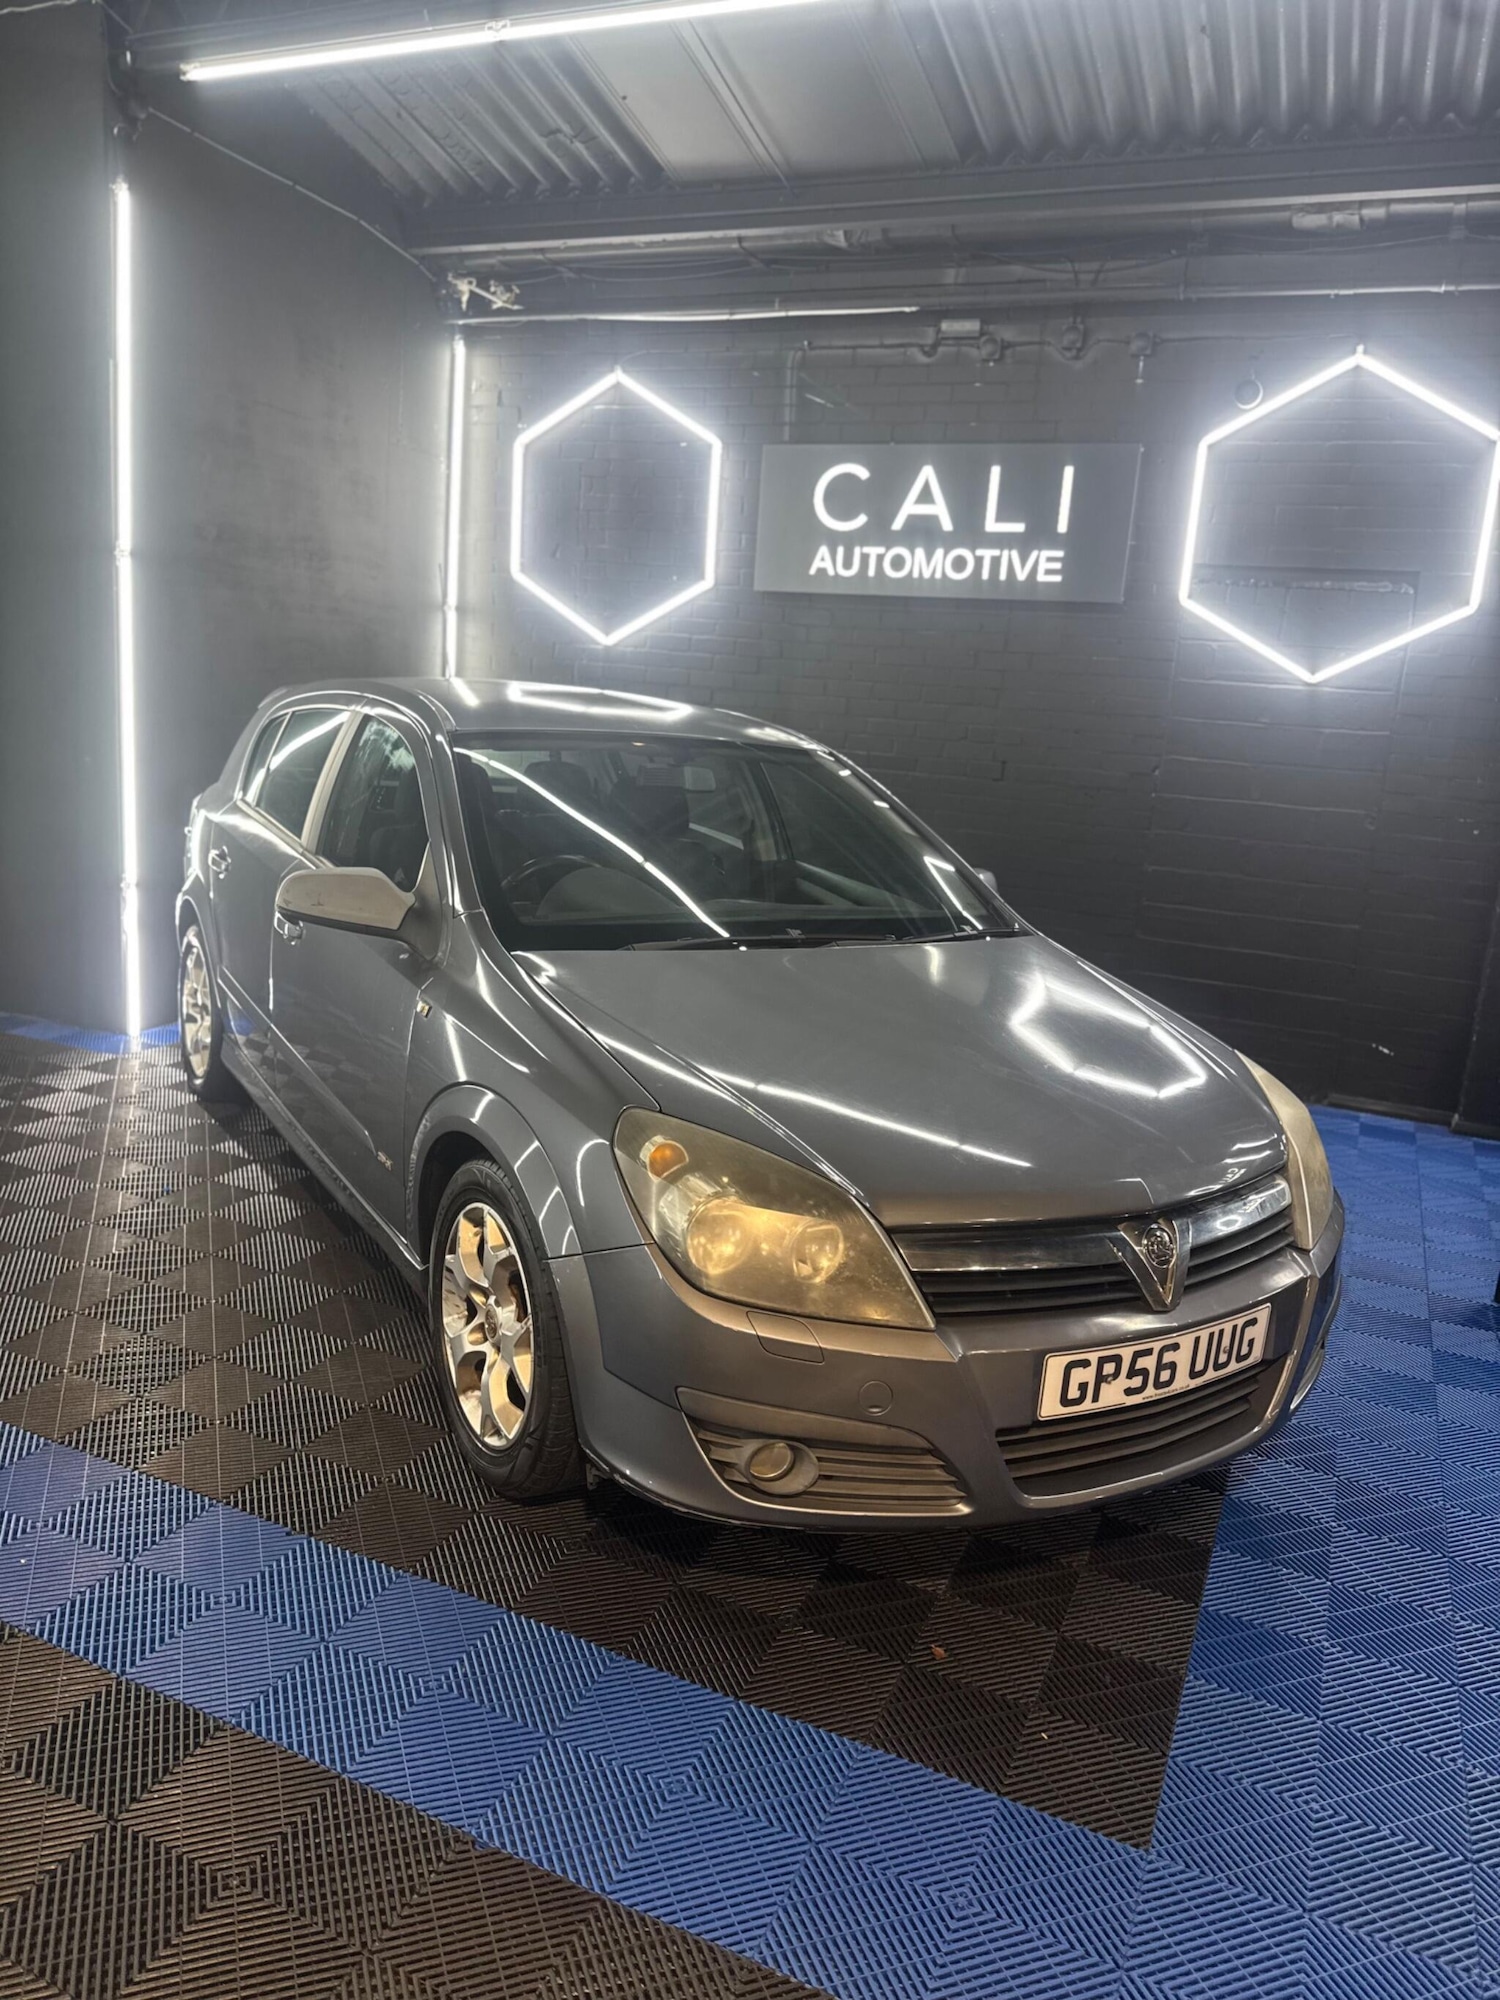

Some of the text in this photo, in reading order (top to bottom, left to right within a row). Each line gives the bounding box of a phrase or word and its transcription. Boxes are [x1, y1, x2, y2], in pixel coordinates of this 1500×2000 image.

[813, 463, 1074, 534] CALI
[809, 545, 1064, 582] AUTOMOTIVE
[1060, 1317, 1258, 1407] GP56 UUG
